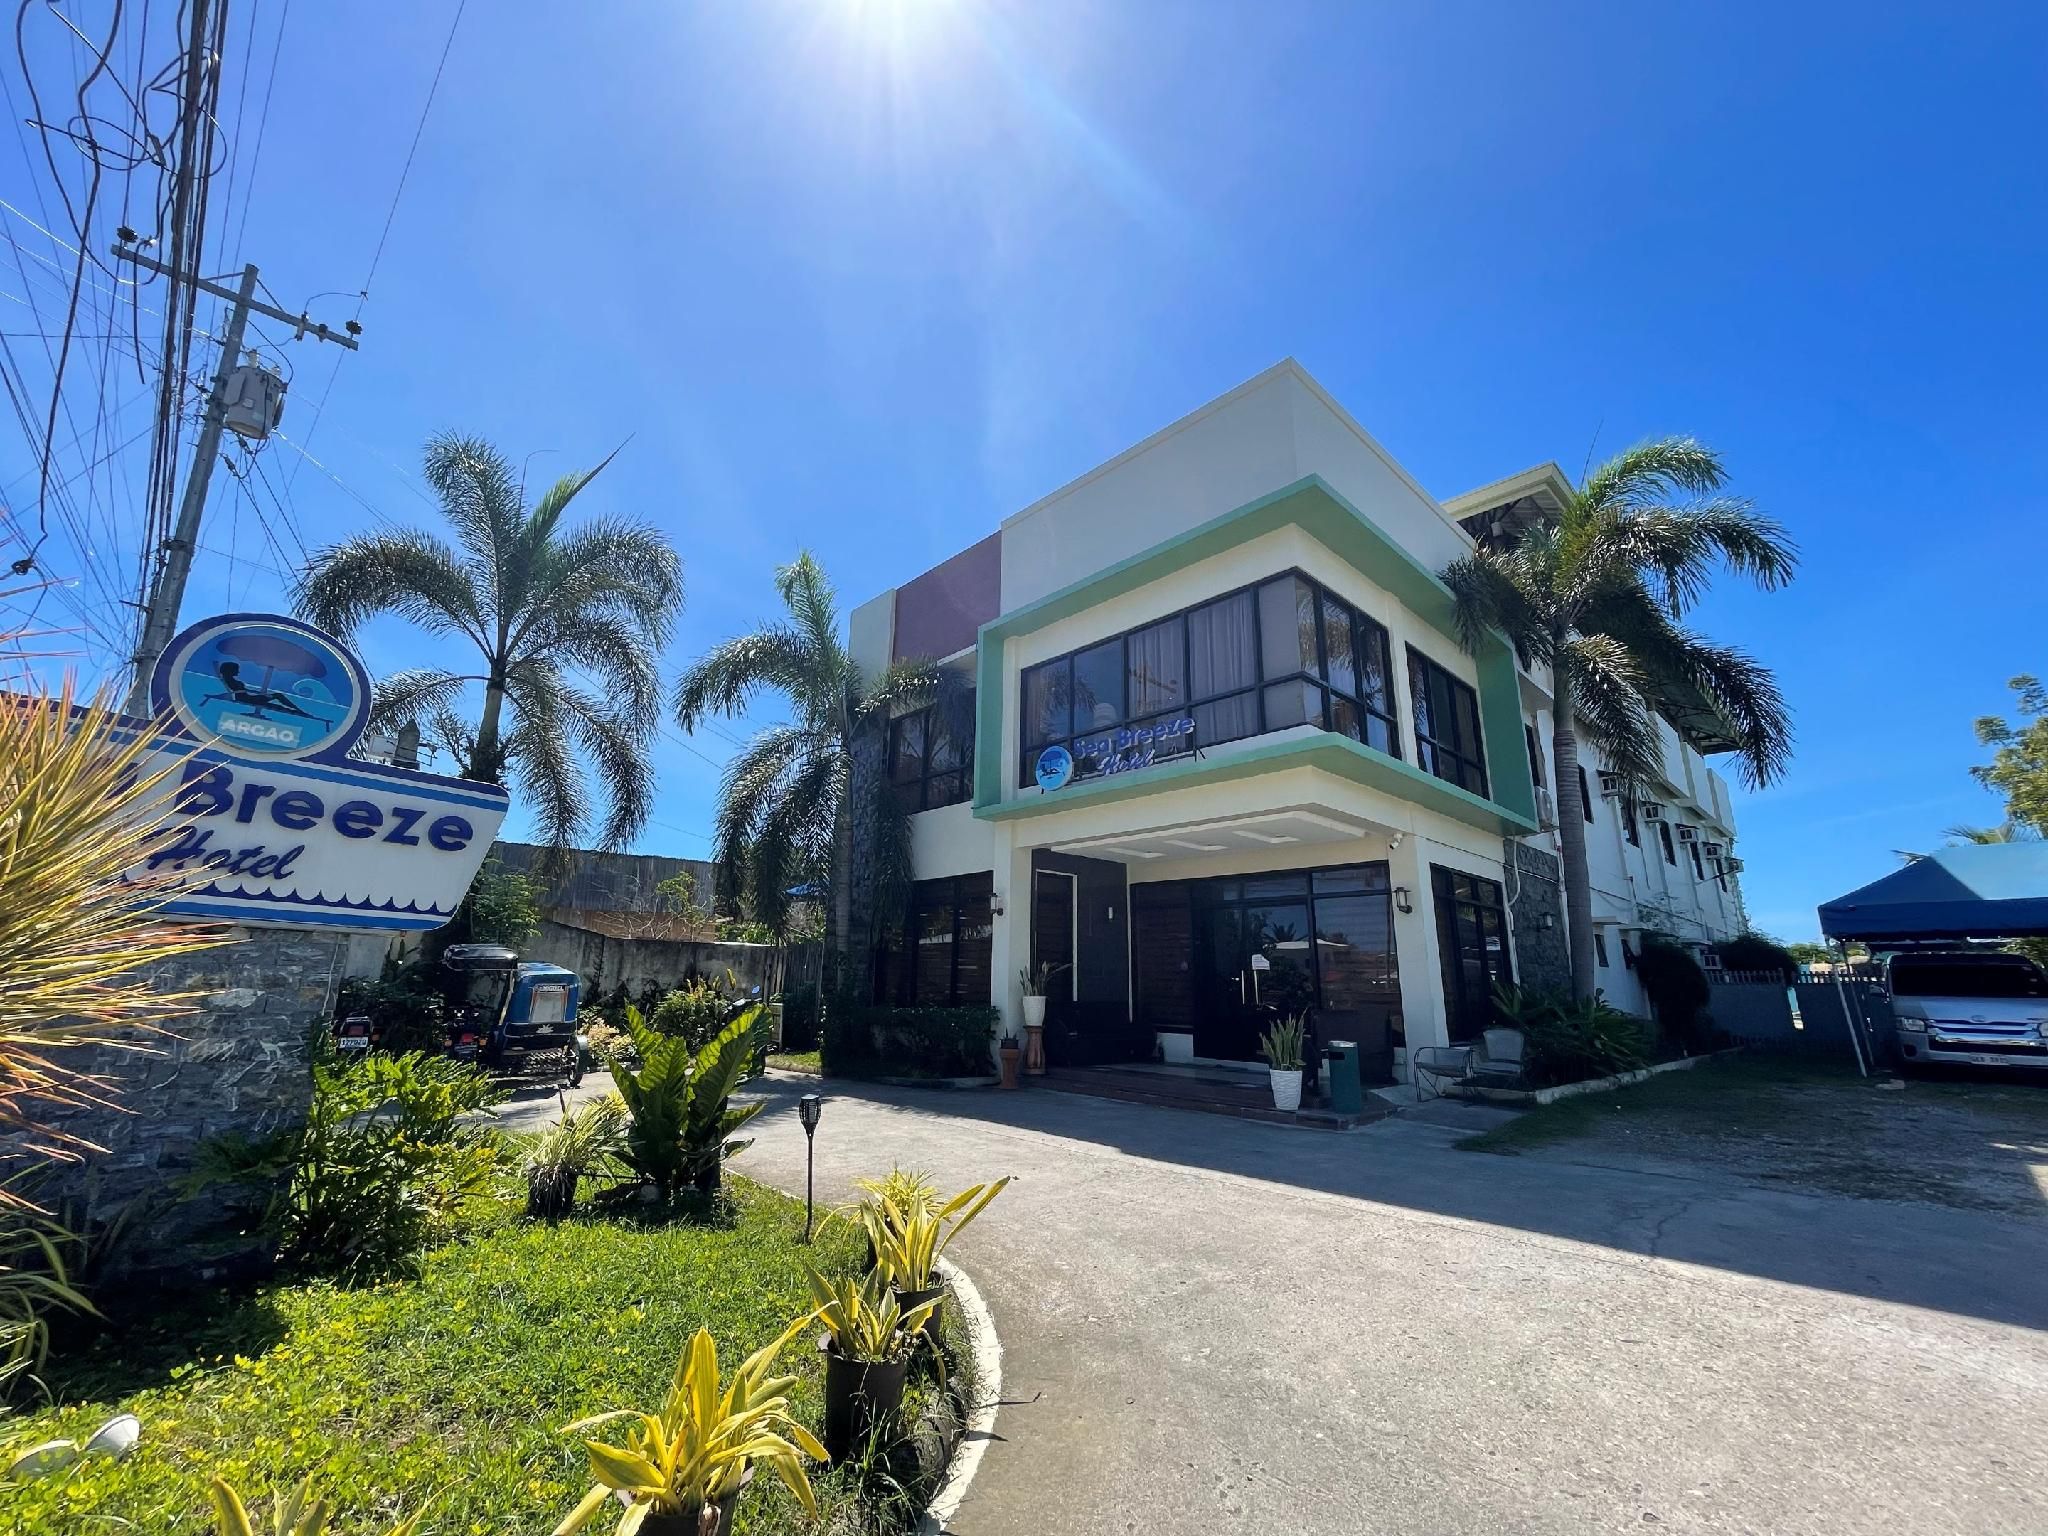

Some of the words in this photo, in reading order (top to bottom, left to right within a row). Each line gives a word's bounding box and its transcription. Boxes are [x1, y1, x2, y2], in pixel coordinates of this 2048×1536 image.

[221, 717, 295, 744] ARGAO
[1115, 716, 1196, 750] Breeze
[1097, 748, 1156, 775] Hotel
[173, 759, 475, 852] Breeze
[140, 825, 305, 881] Hotel
